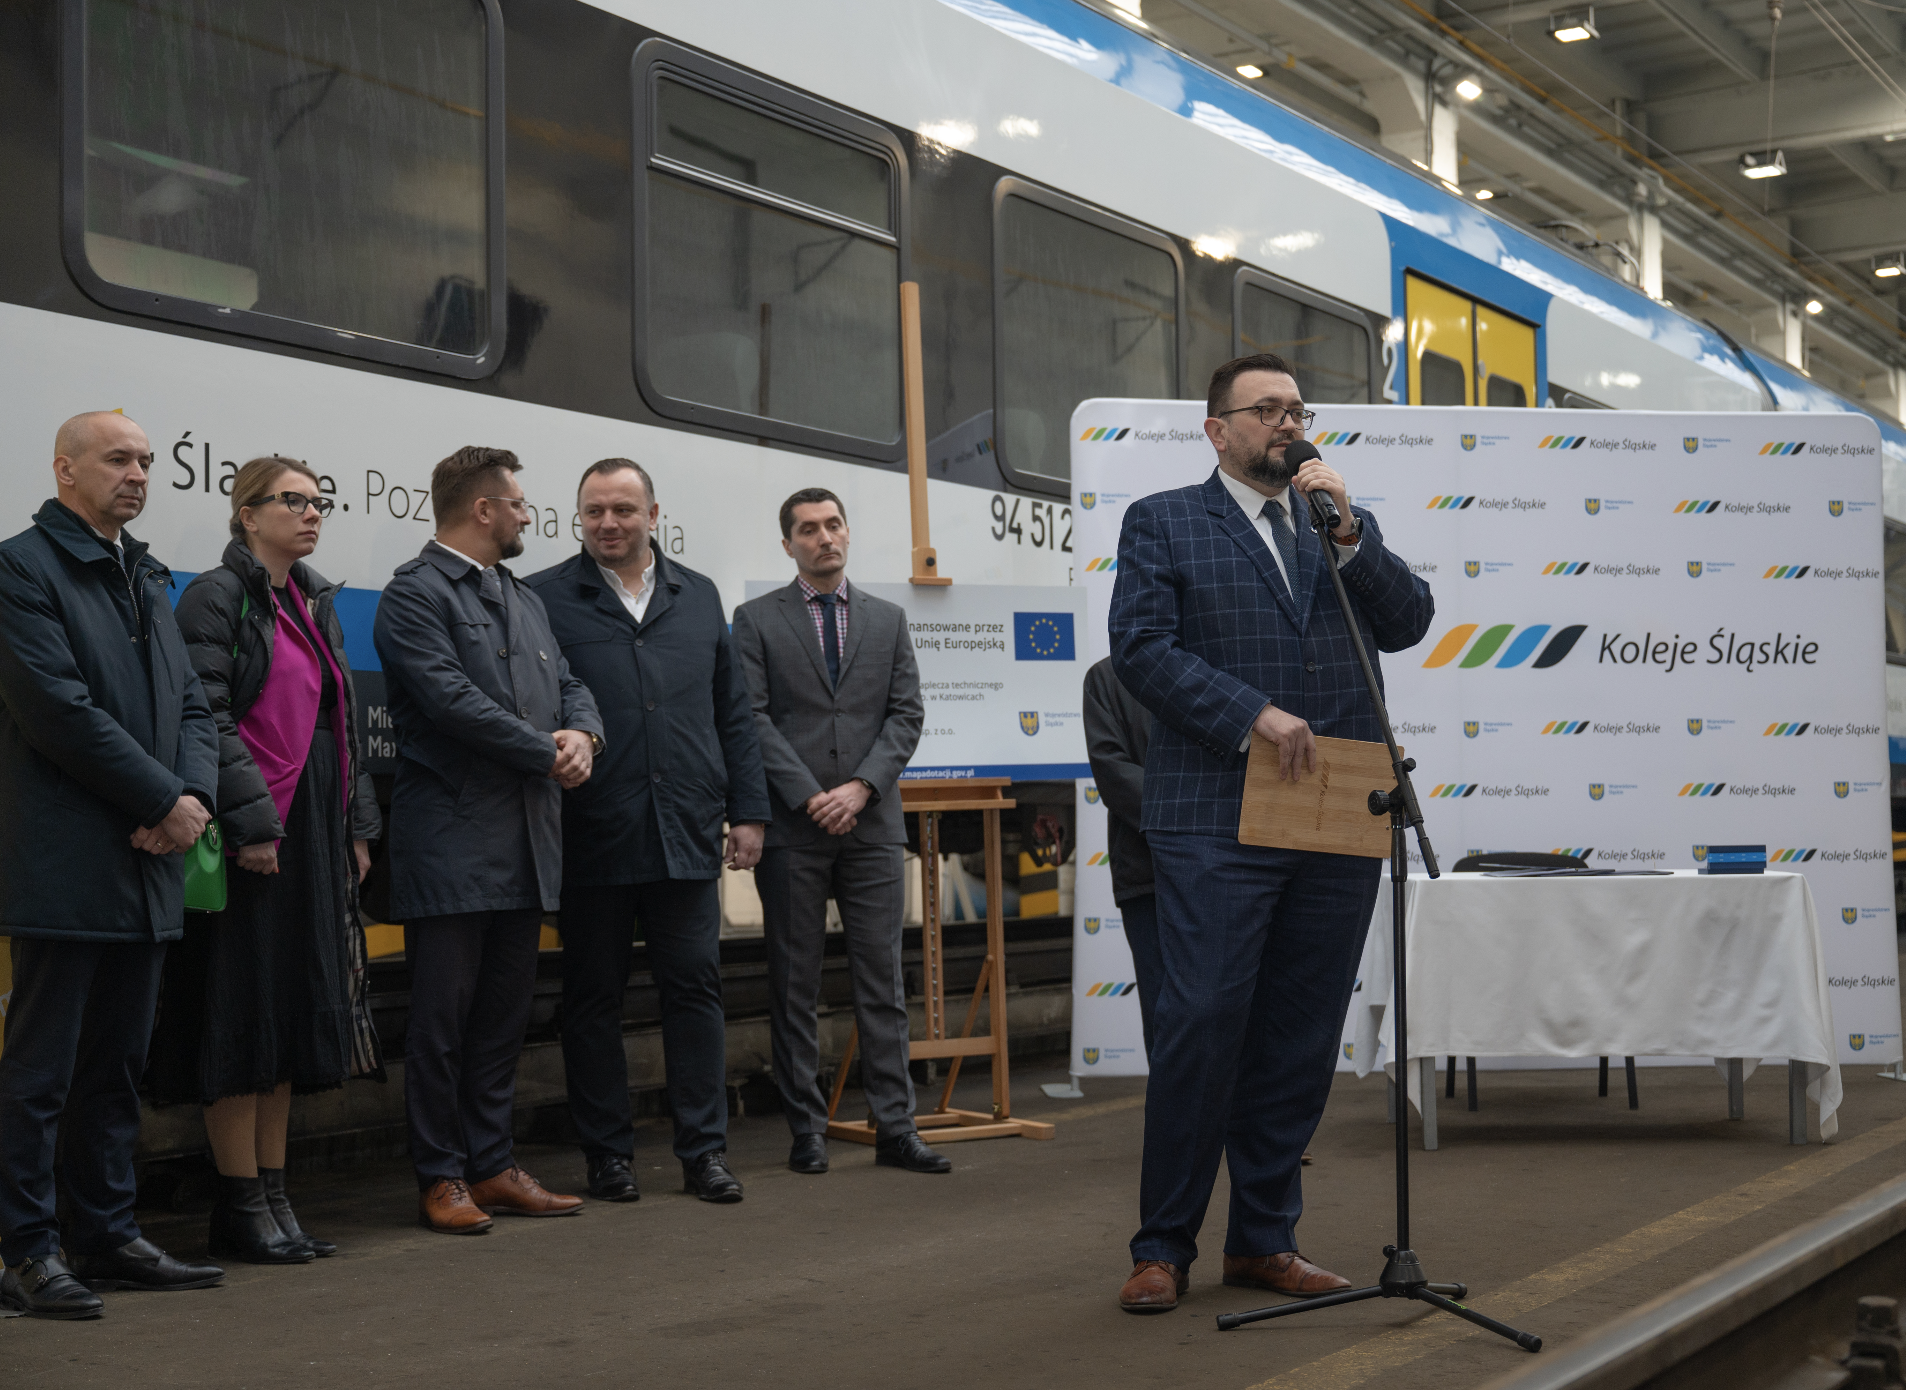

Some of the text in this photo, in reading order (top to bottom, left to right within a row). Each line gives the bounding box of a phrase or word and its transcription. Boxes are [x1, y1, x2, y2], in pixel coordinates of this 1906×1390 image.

[1381, 341, 1399, 402] 2
[1134, 428, 1204, 443] Koleje Śląskie
[1365, 432, 1434, 447] Koleje Śląskie
[1590, 437, 1657, 452] Koleje Śląskie
[1809, 442, 1875, 457] Koleje Śląskie
[1478, 496, 1546, 511] Koleje Śląskie
[1724, 501, 1791, 515] Koleje Śląskie
[991, 494, 1022, 545] 94
[1030, 501, 1054, 550] 51
[1406, 560, 1437, 574] ląskie
[1593, 562, 1660, 577] Koleje Śląskie
[1813, 566, 1879, 580] Koleje Śląskie
[906, 620, 1004, 635] nansowane przez
[915, 637, 1005, 652] Unię Europejską
[1599, 628, 1819, 673] Koleje Śląskie
[951, 680, 1004, 692] technicznego
[939, 693, 985, 701] Katowicach
[940, 728, 956, 736] o.o.
[1401, 722, 1436, 736] Śląskie
[1593, 721, 1661, 736] Koleje Śląskie
[1813, 723, 1880, 737] Koleje Śląskie
[1481, 783, 1549, 798] Koleje Śląskie
[1729, 783, 1796, 797] Koleje Śląskie
[1597, 847, 1665, 862] Koleje Śląskie
[1820, 848, 1888, 863] Koleje Śląskie
[1828, 975, 1895, 989] Koleje Śląskie
